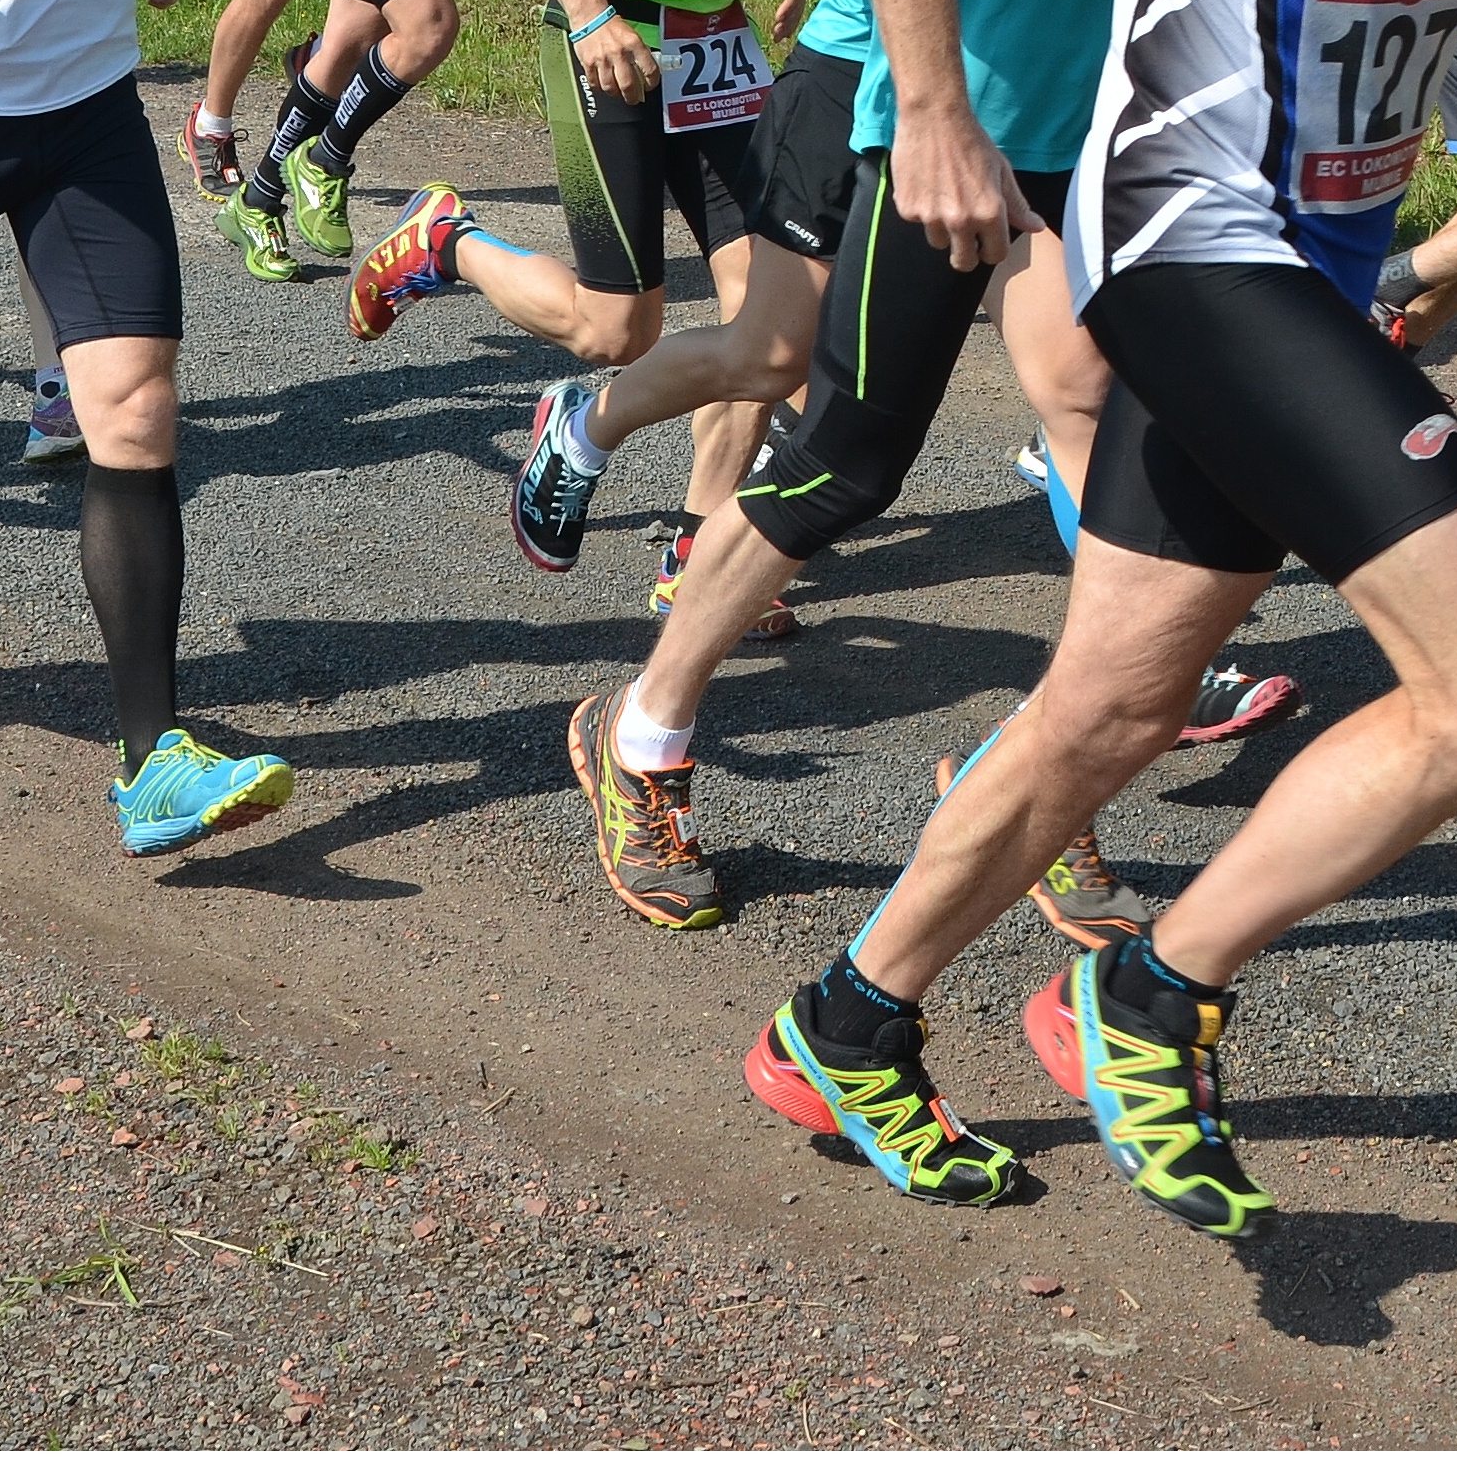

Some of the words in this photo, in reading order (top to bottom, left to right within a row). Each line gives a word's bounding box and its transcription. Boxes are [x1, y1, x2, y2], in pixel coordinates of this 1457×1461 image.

[679, 35, 756, 96] 224
[579, 74, 597, 112] CRAFT
[687, 102, 702, 113] EC
[703, 91, 762, 111] LOKOMOTIVA
[712, 106, 746, 119] MUMIE
[1316, 161, 1346, 177] EC
[784, 220, 815, 243] CRAFT
